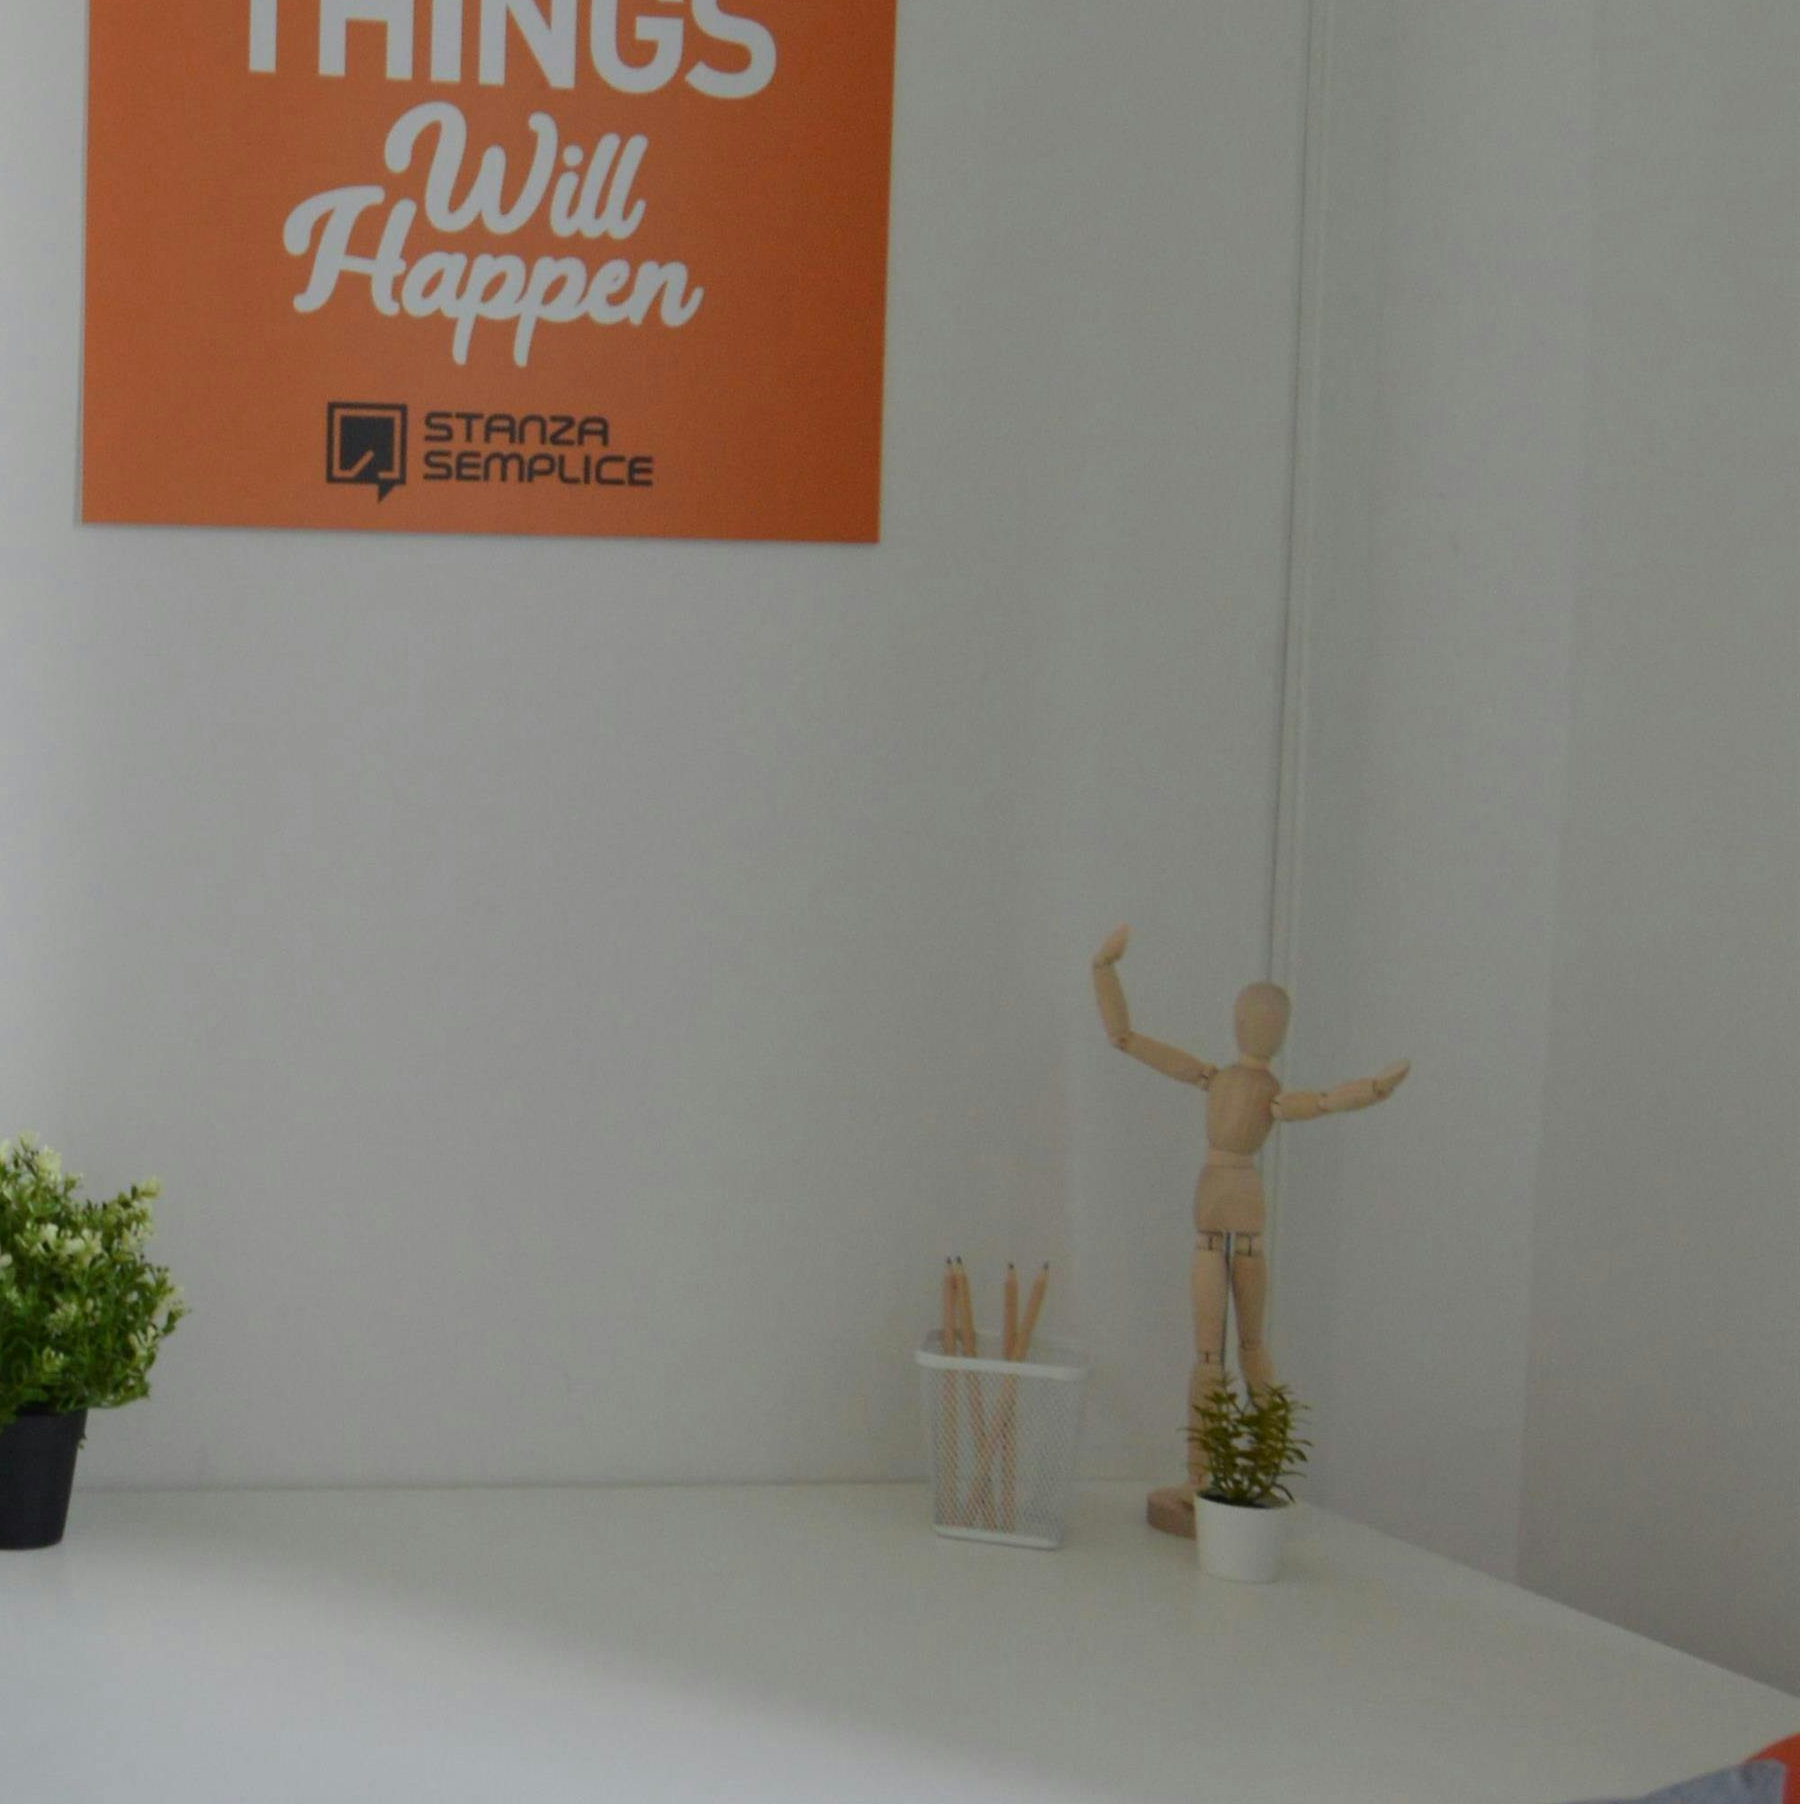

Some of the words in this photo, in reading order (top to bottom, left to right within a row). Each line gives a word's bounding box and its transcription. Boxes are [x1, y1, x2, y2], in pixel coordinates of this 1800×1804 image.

[384, 101, 648, 240] Will
[283, 184, 703, 366] Happen
[422, 411, 610, 447] STANZA
[422, 449, 654, 487] SEMPLICE
